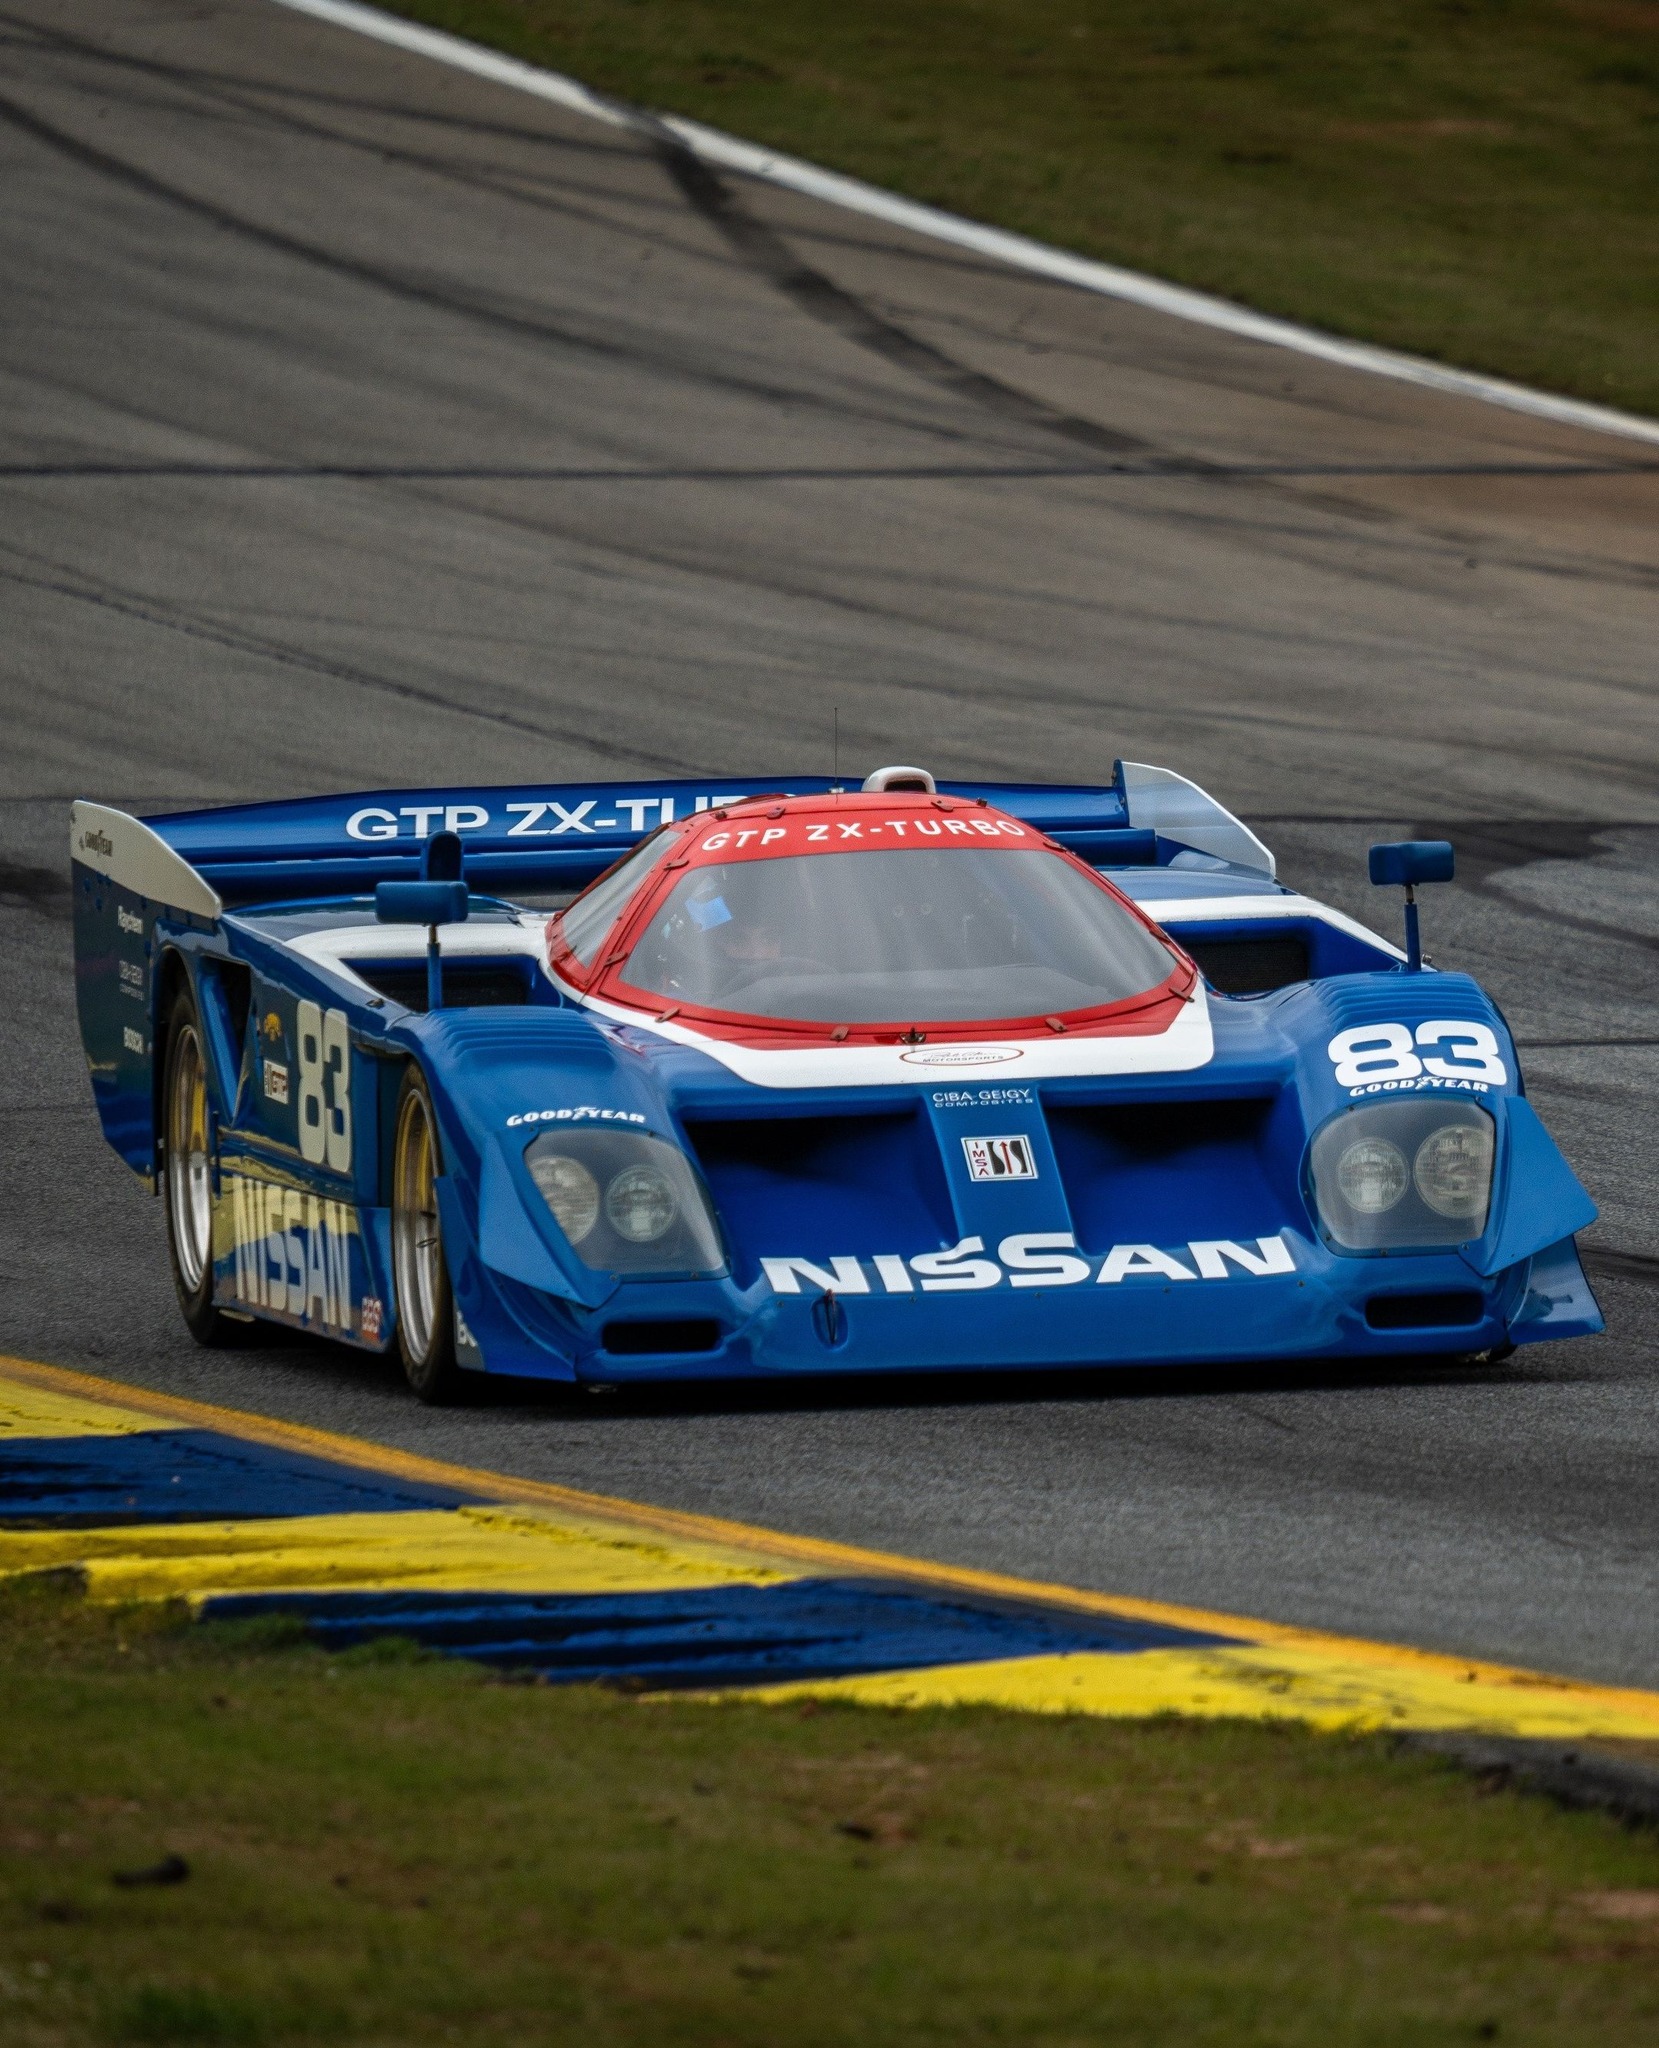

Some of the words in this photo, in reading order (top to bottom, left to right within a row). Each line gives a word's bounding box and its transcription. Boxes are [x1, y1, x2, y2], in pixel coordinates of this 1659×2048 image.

[346, 806, 489, 841] GTP
[506, 794, 760, 836] ZX-TU
[701, 827, 788, 851] GTP
[805, 819, 1025, 842] ZX-TURBO
[922, 1055, 1004, 1063] MOTORSPORTS
[1327, 1020, 1507, 1087] 83
[297, 999, 350, 1174] 83
[934, 1098, 1034, 1108] COMPOSITES
[1349, 1076, 1489, 1097] GOODYEAR
[506, 1106, 646, 1127] GOODYEAR
[232, 1175, 351, 1330] NISSAN
[759, 1232, 1296, 1294] NISSAN
